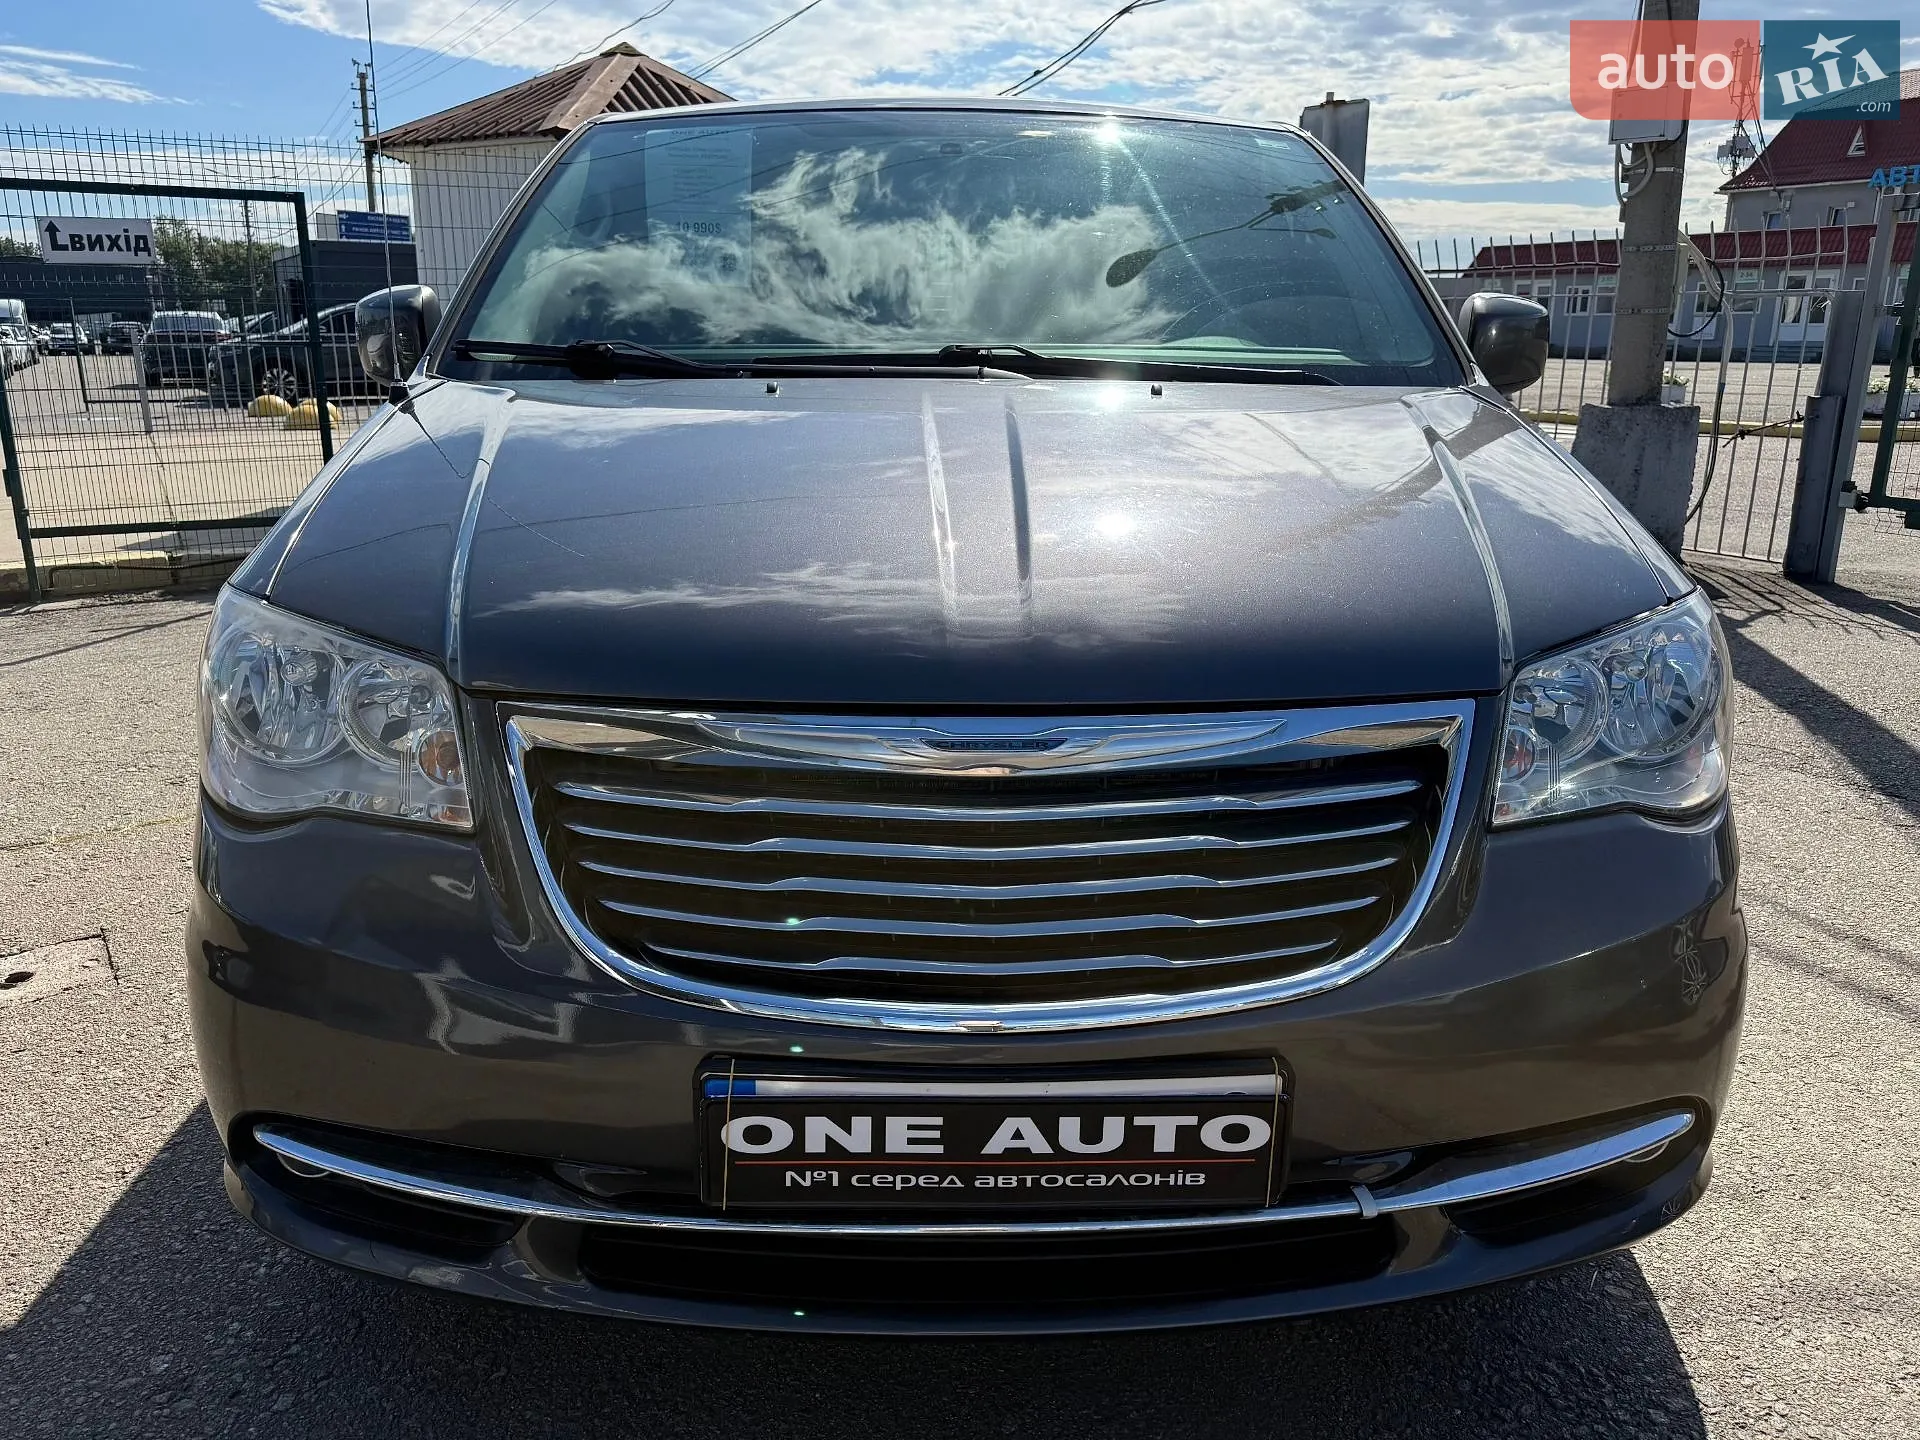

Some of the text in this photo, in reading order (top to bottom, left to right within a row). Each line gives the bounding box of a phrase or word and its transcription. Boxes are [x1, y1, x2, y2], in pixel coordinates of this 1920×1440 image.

[68, 228, 152, 257] вихід
[720, 1114, 1271, 1154] ONE AUTO
[851, 1173, 964, 1191] серед
[974, 1169, 1206, 1188] автосалонів
